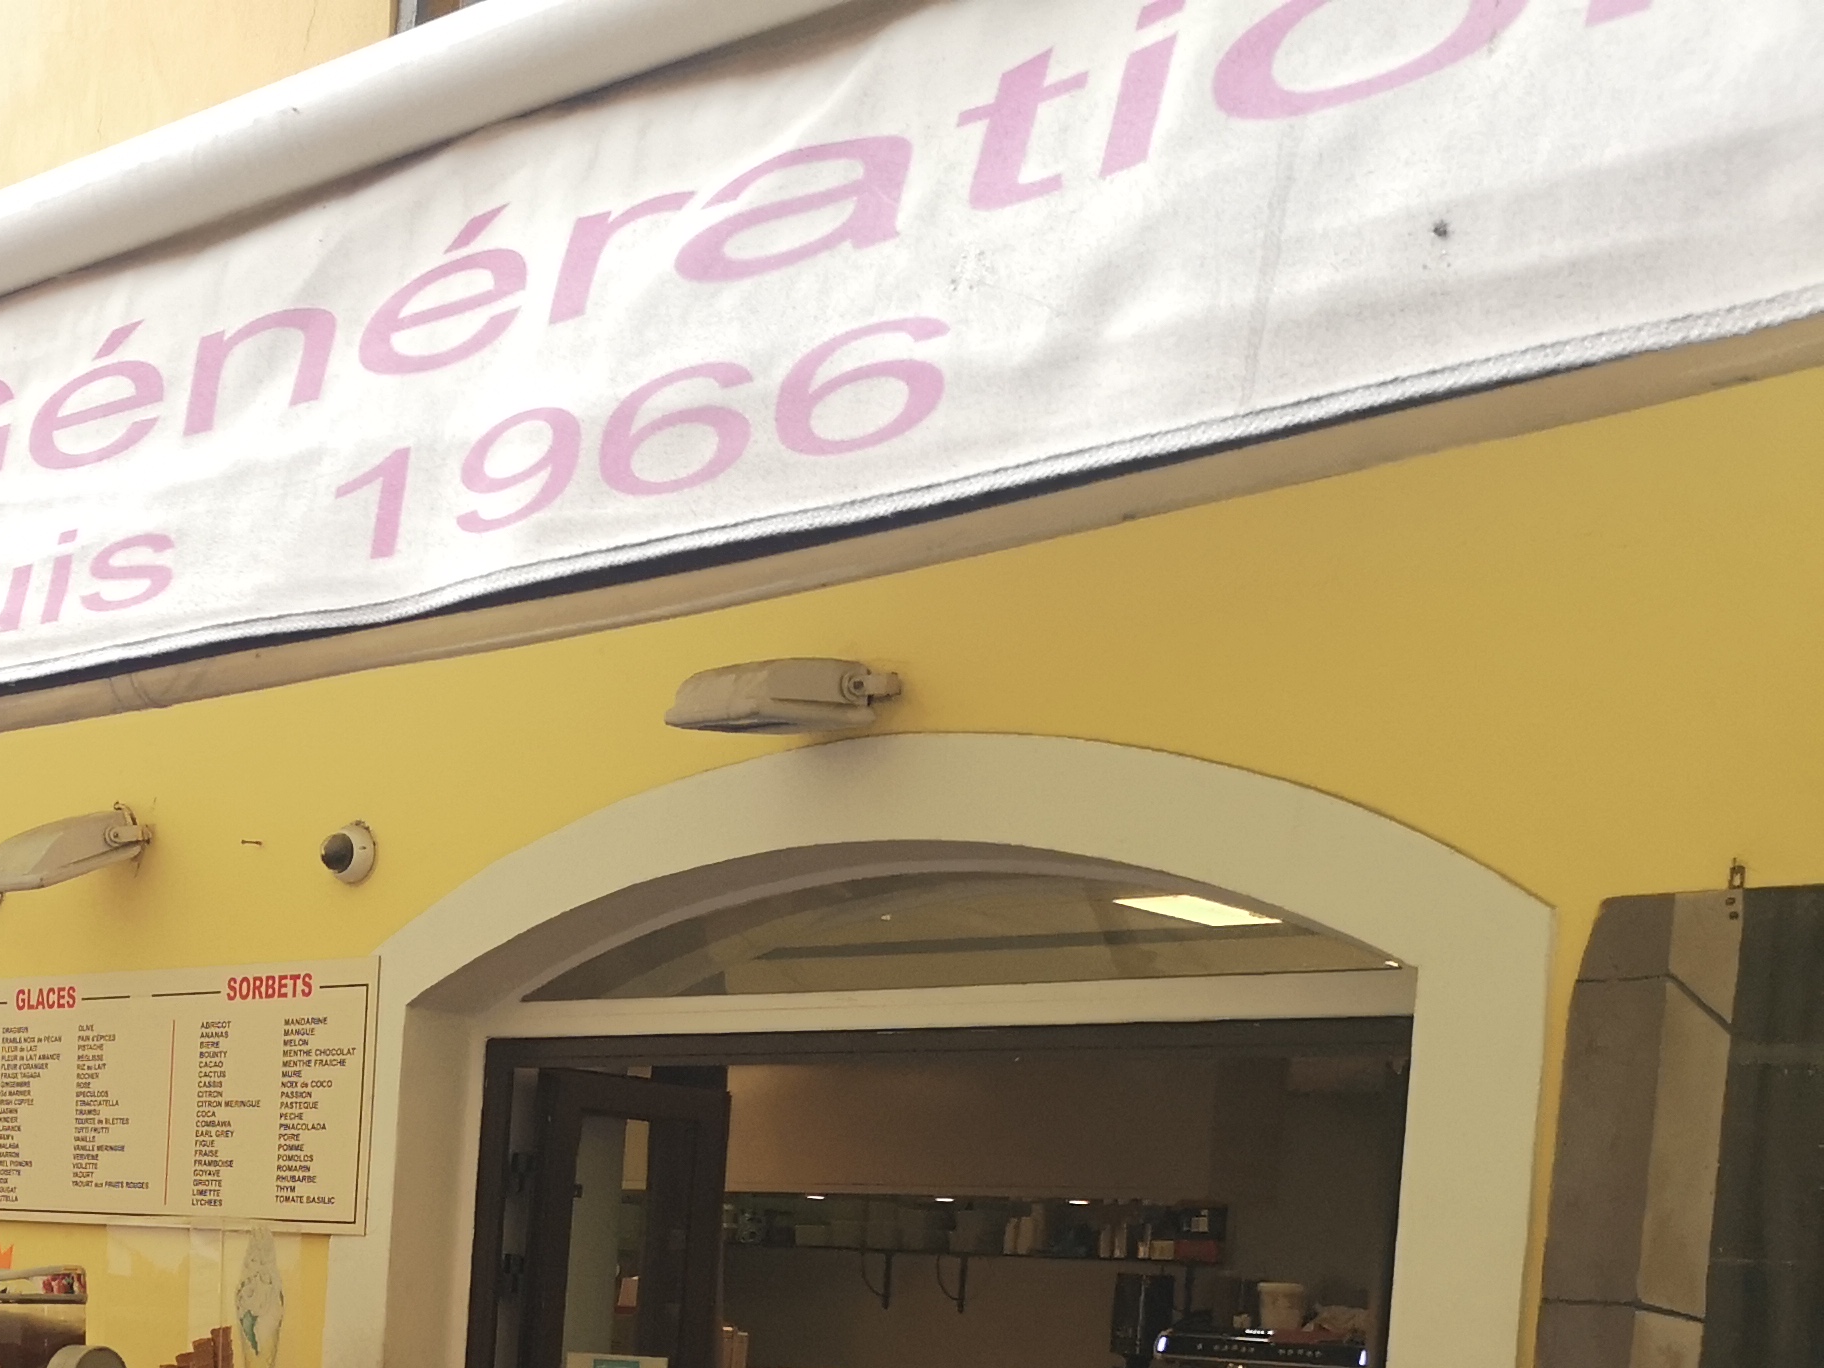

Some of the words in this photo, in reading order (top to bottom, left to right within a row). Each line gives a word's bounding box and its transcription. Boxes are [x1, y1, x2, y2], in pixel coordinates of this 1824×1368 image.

[332, 314, 953, 561] 1966
[16, 986, 76, 1012] GLACES
[226, 972, 313, 1002] SORBETS
[200, 1021, 231, 1029] ABRICOT
[284, 1016, 327, 1026] MANDARINE
[283, 1028, 315, 1036] MANGUE
[283, 1039, 308, 1047] MELON
[199, 1050, 227, 1058] BOUNTY
[282, 1049, 312, 1057] MENTHE
[315, 1047, 356, 1057] CHOCOLAT
[282, 1059, 312, 1067] MENTHE
[311, 1080, 333, 1088] COCO
[281, 1091, 312, 1099] PASSION
[197, 1100, 223, 1108] CITRON
[278, 1144, 304, 1152] POMME
[193, 1169, 220, 1177] GOYAVE
[276, 1185, 295, 1193] THYM
[192, 1199, 222, 1207] LYCHEES
[275, 1195, 304, 1204] TOMATE
[306, 1196, 335, 1205] BASILIC
